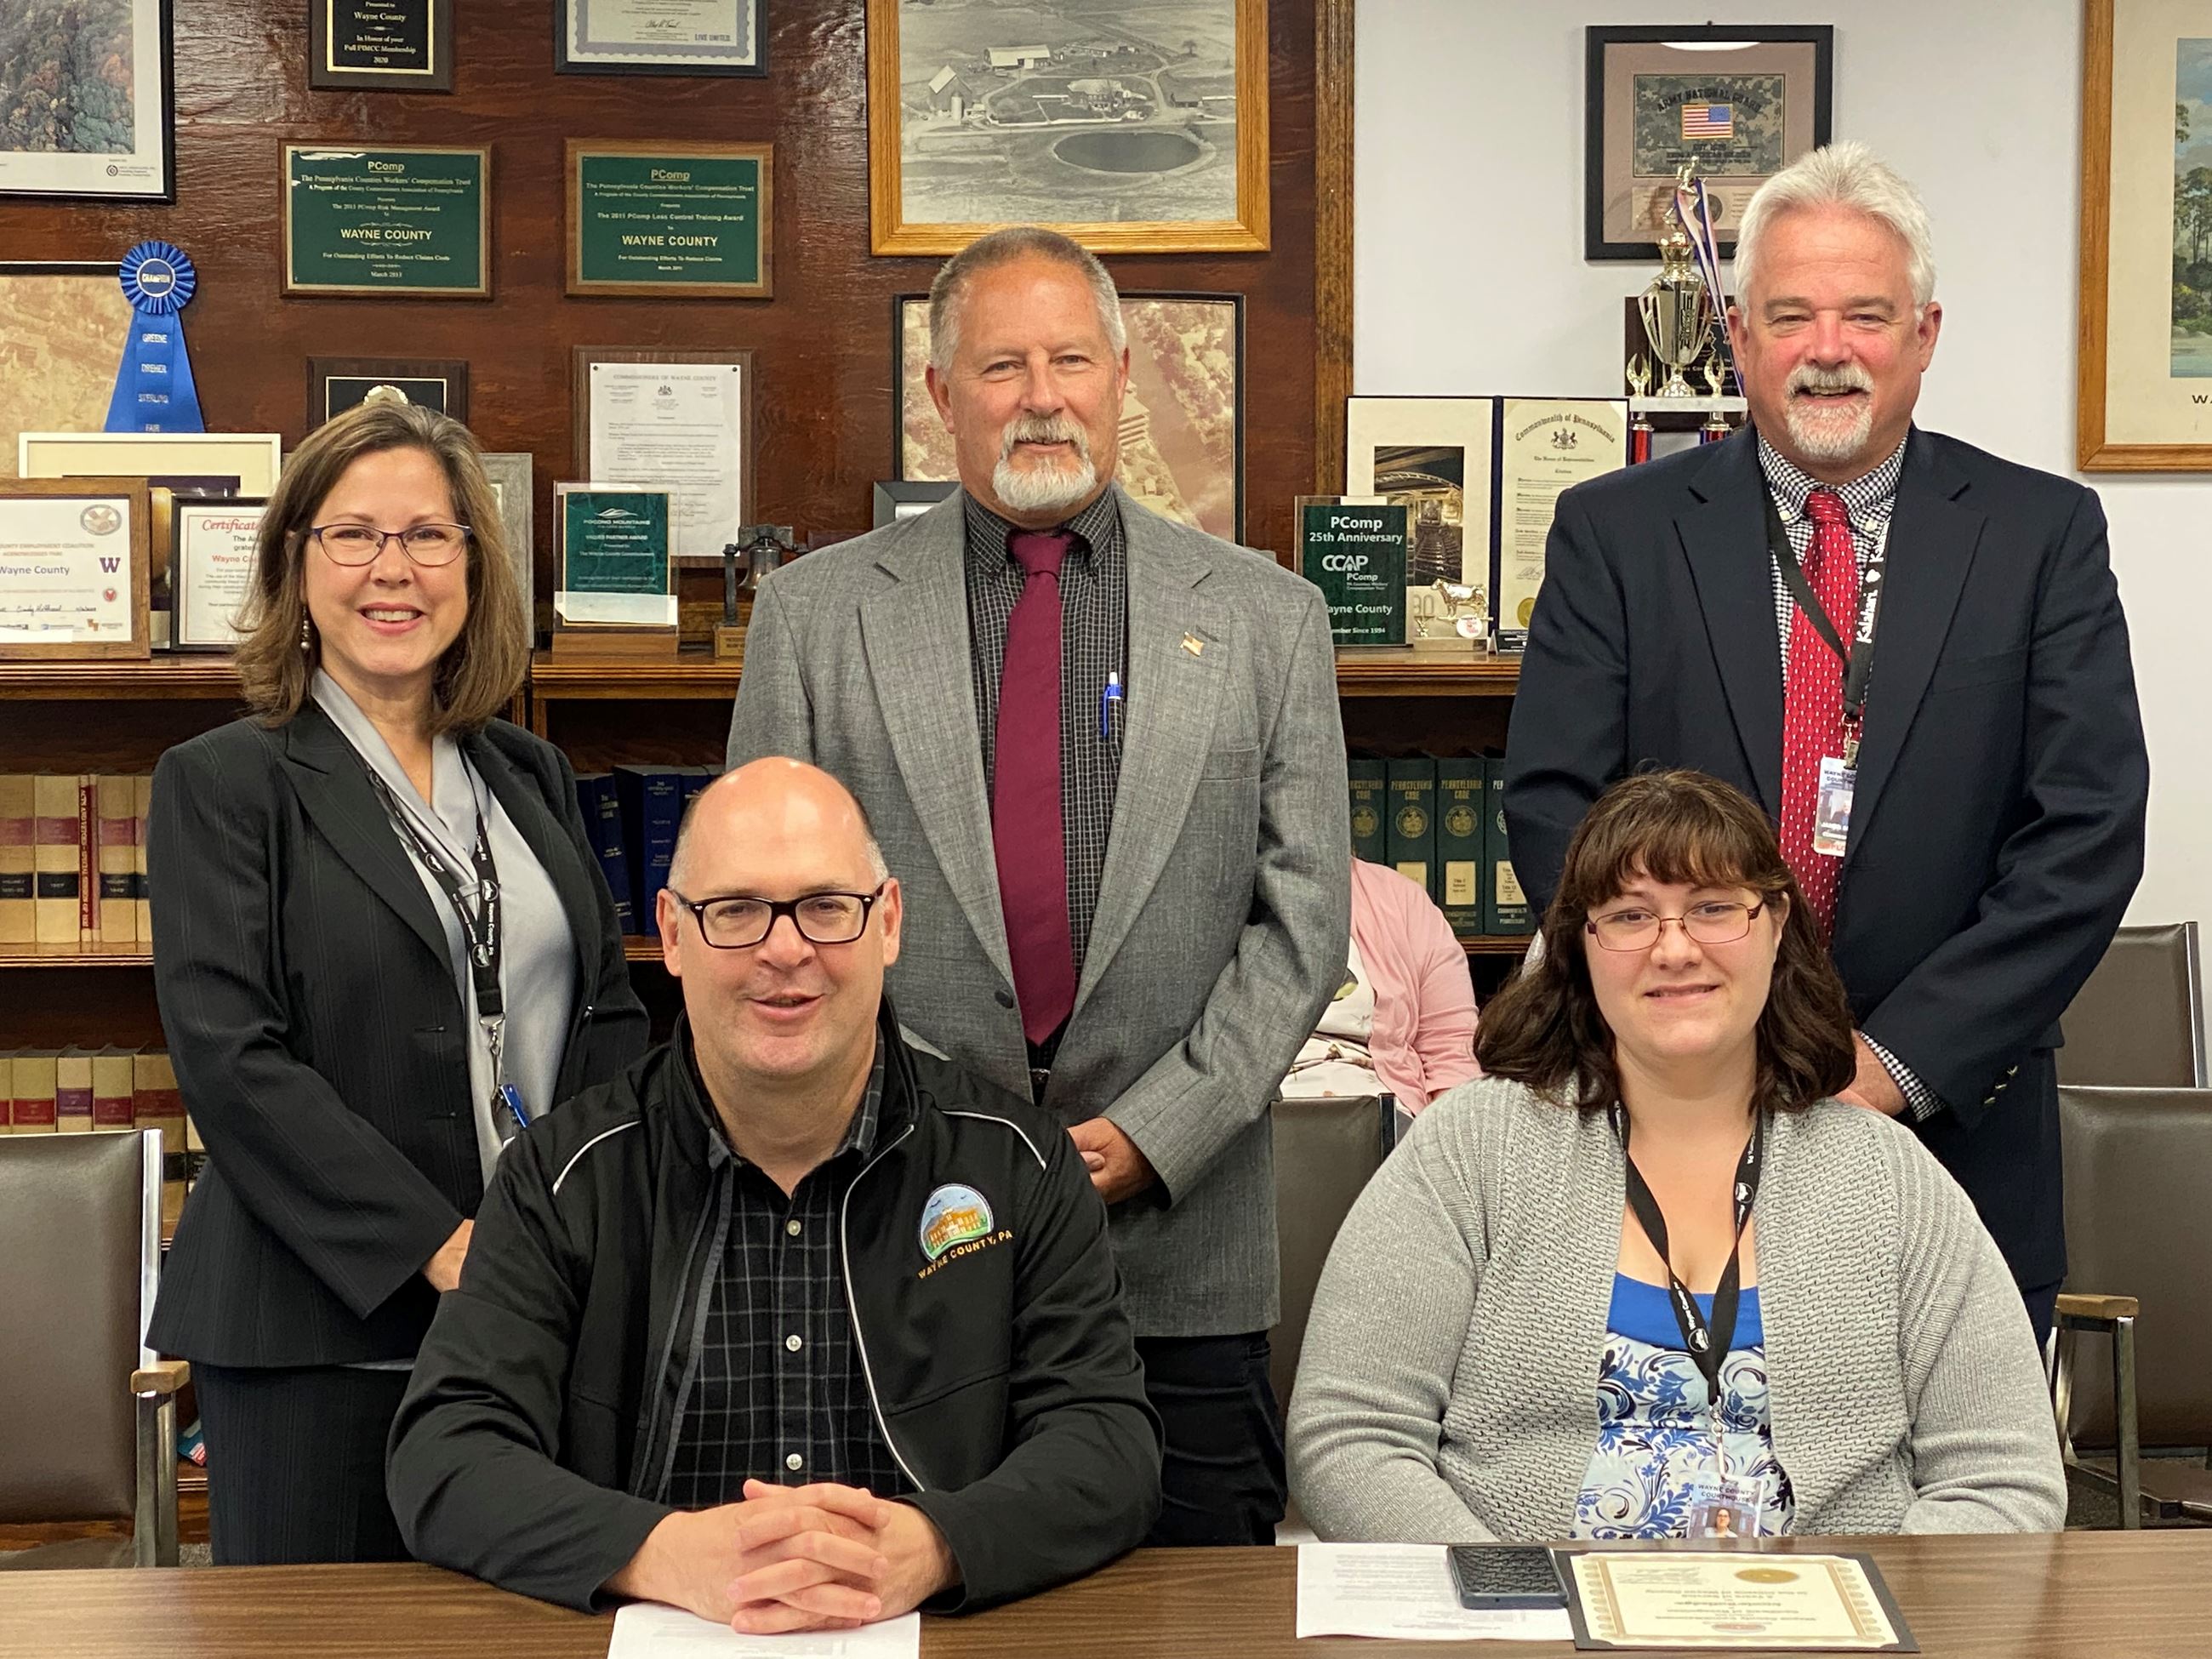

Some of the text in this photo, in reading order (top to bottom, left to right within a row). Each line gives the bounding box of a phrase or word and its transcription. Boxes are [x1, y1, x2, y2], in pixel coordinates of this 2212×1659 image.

[354, 11, 407, 23] Wayne County
[1656, 87, 1763, 114] ARMY NATIONAL GUARD
[368, 161, 405, 174] PComp
[314, 174, 354, 184] Pennsylvania
[651, 169, 690, 182] PComp
[695, 214, 721, 222] Training
[340, 229, 432, 240] WAYNE COUNTY
[622, 235, 718, 247] WAYNE COUNTY
[142, 334, 168, 344] GREENE
[138, 393, 169, 404] STERLING
[1515, 413, 1564, 442] Commonwealth
[1573, 414, 1615, 443] Pennsylvania
[201, 518, 259, 534] Certificat
[1331, 516, 1383, 532] PComp
[1309, 533, 1403, 544] 25th Anniversary
[212, 555, 240, 563] Wayne
[1322, 555, 1369, 571] CCAP
[100, 557, 121, 573] W
[0, 566, 70, 576] Wayne County
[1347, 573, 1378, 582] PComp
[1325, 604, 1393, 615] ayne County
[1856, 590, 1878, 644] Kalahari
[1391, 780, 1433, 790] PENNSYLVANIA
[1441, 780, 1482, 790] PENNSYLVANIA
[1405, 790, 1420, 801] CODE
[1454, 790, 1470, 800] CODE
[918, 1229, 1013, 1280] WAYNE COUNTY, PA
[1697, 1483, 1755, 1496] WAYNE COUNTY
[1701, 1491, 1752, 1502] COURTHOUSE
